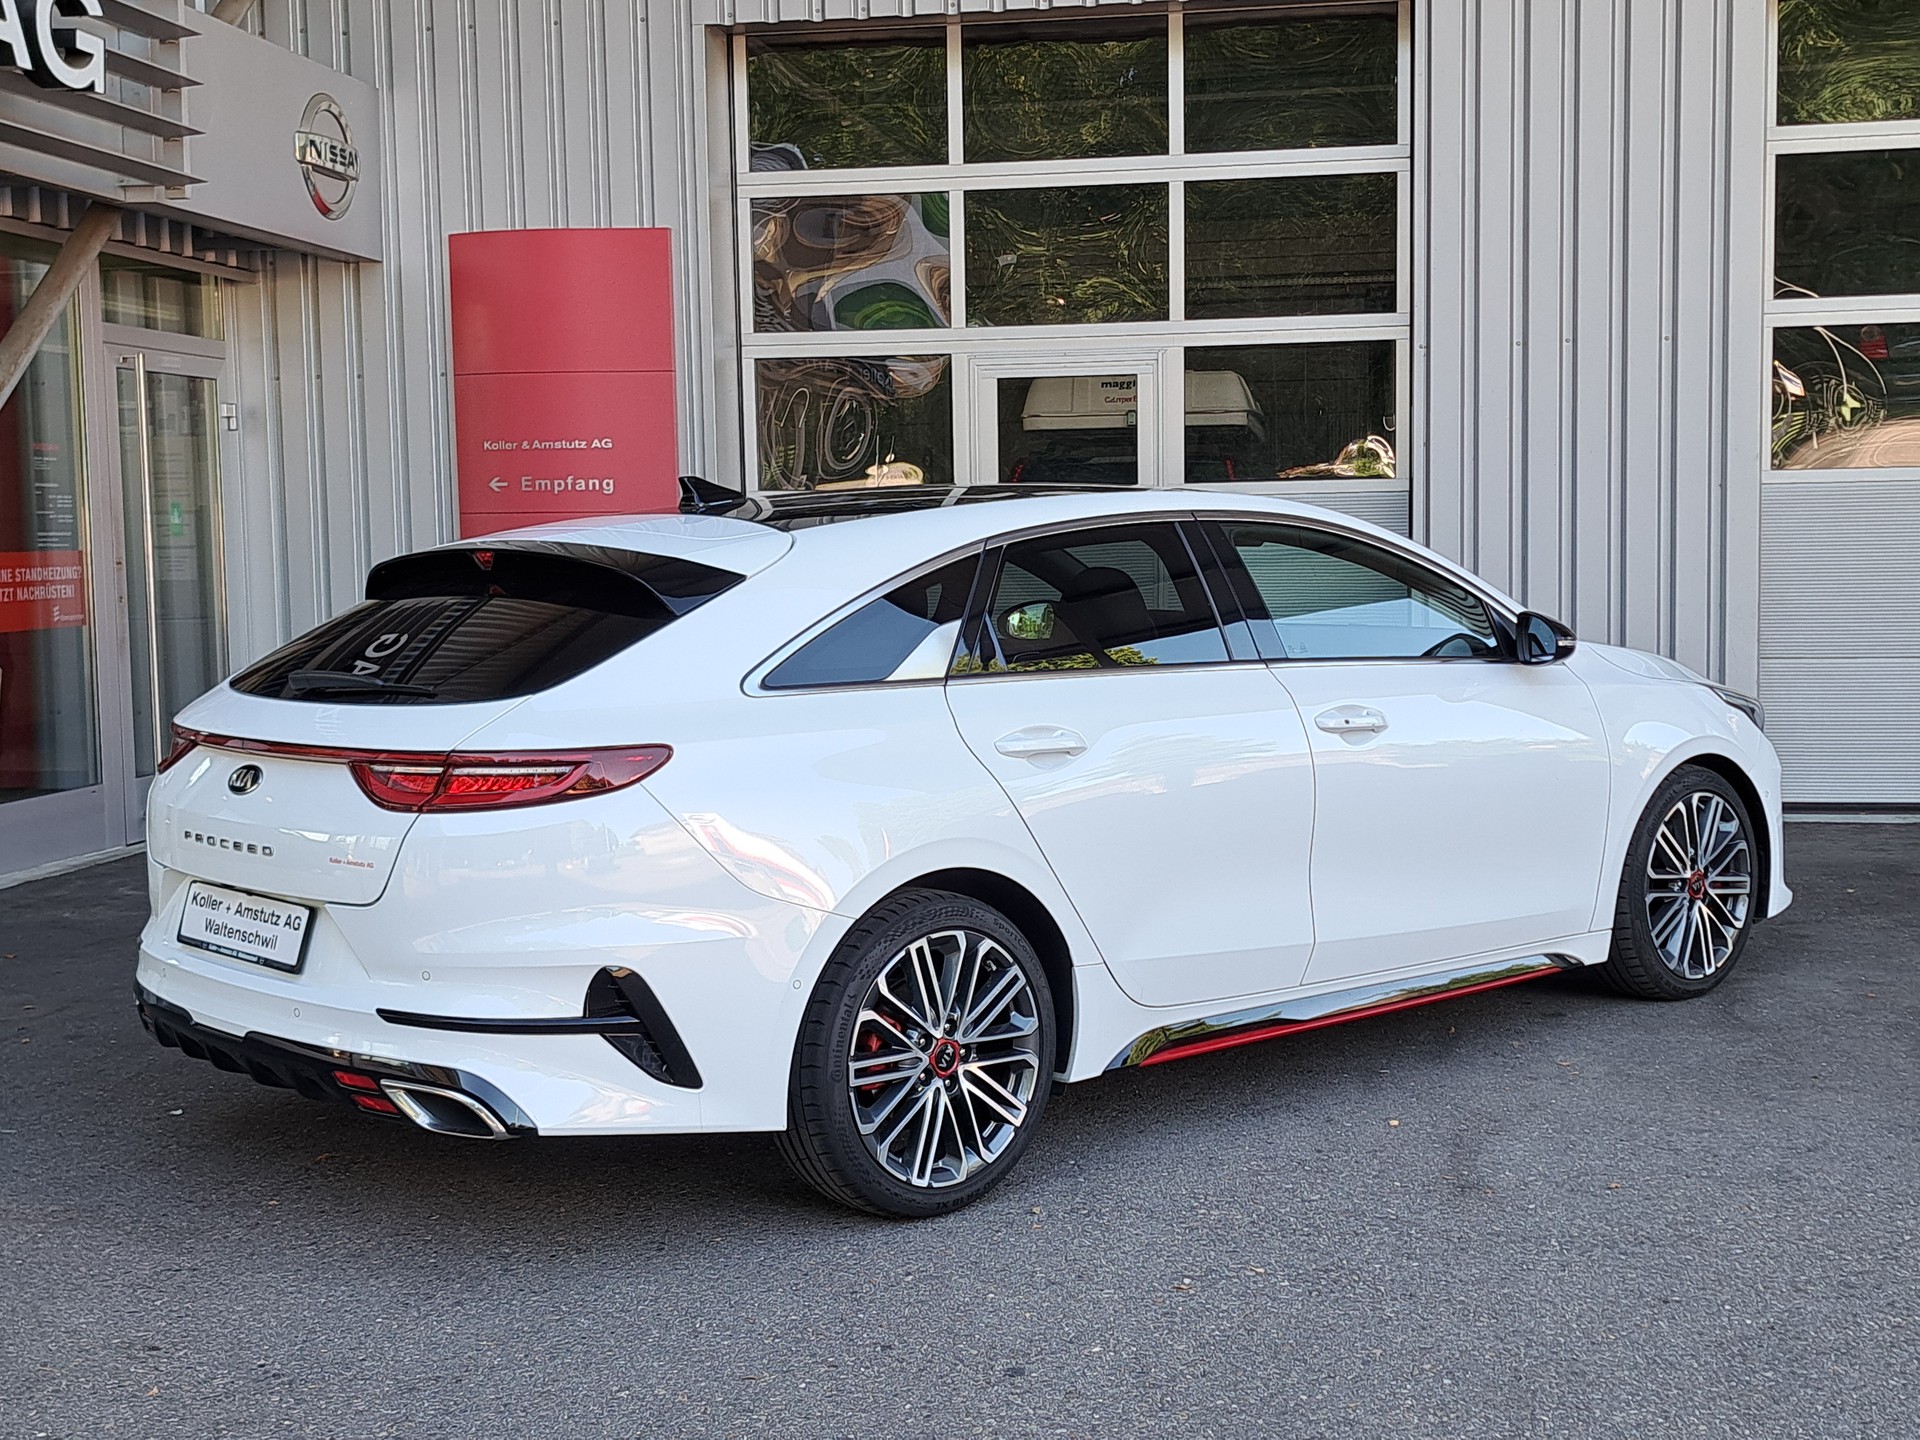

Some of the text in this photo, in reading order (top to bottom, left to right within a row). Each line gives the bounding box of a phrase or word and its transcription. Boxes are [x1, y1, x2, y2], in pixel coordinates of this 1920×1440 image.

[483, 438, 613, 450] Koller & Amstutz AG
[521, 475, 615, 494] Empfang
[15, 566, 82, 583] STANDHEIZUNG?
[16, 583, 75, 602] NACHRÜSTEN!
[184, 830, 275, 857] PROCEED
[191, 891, 302, 931] Koller + Amstutz AG
[204, 917, 278, 951] Waltenschwil
[831, 1002, 855, 1082] Continental
